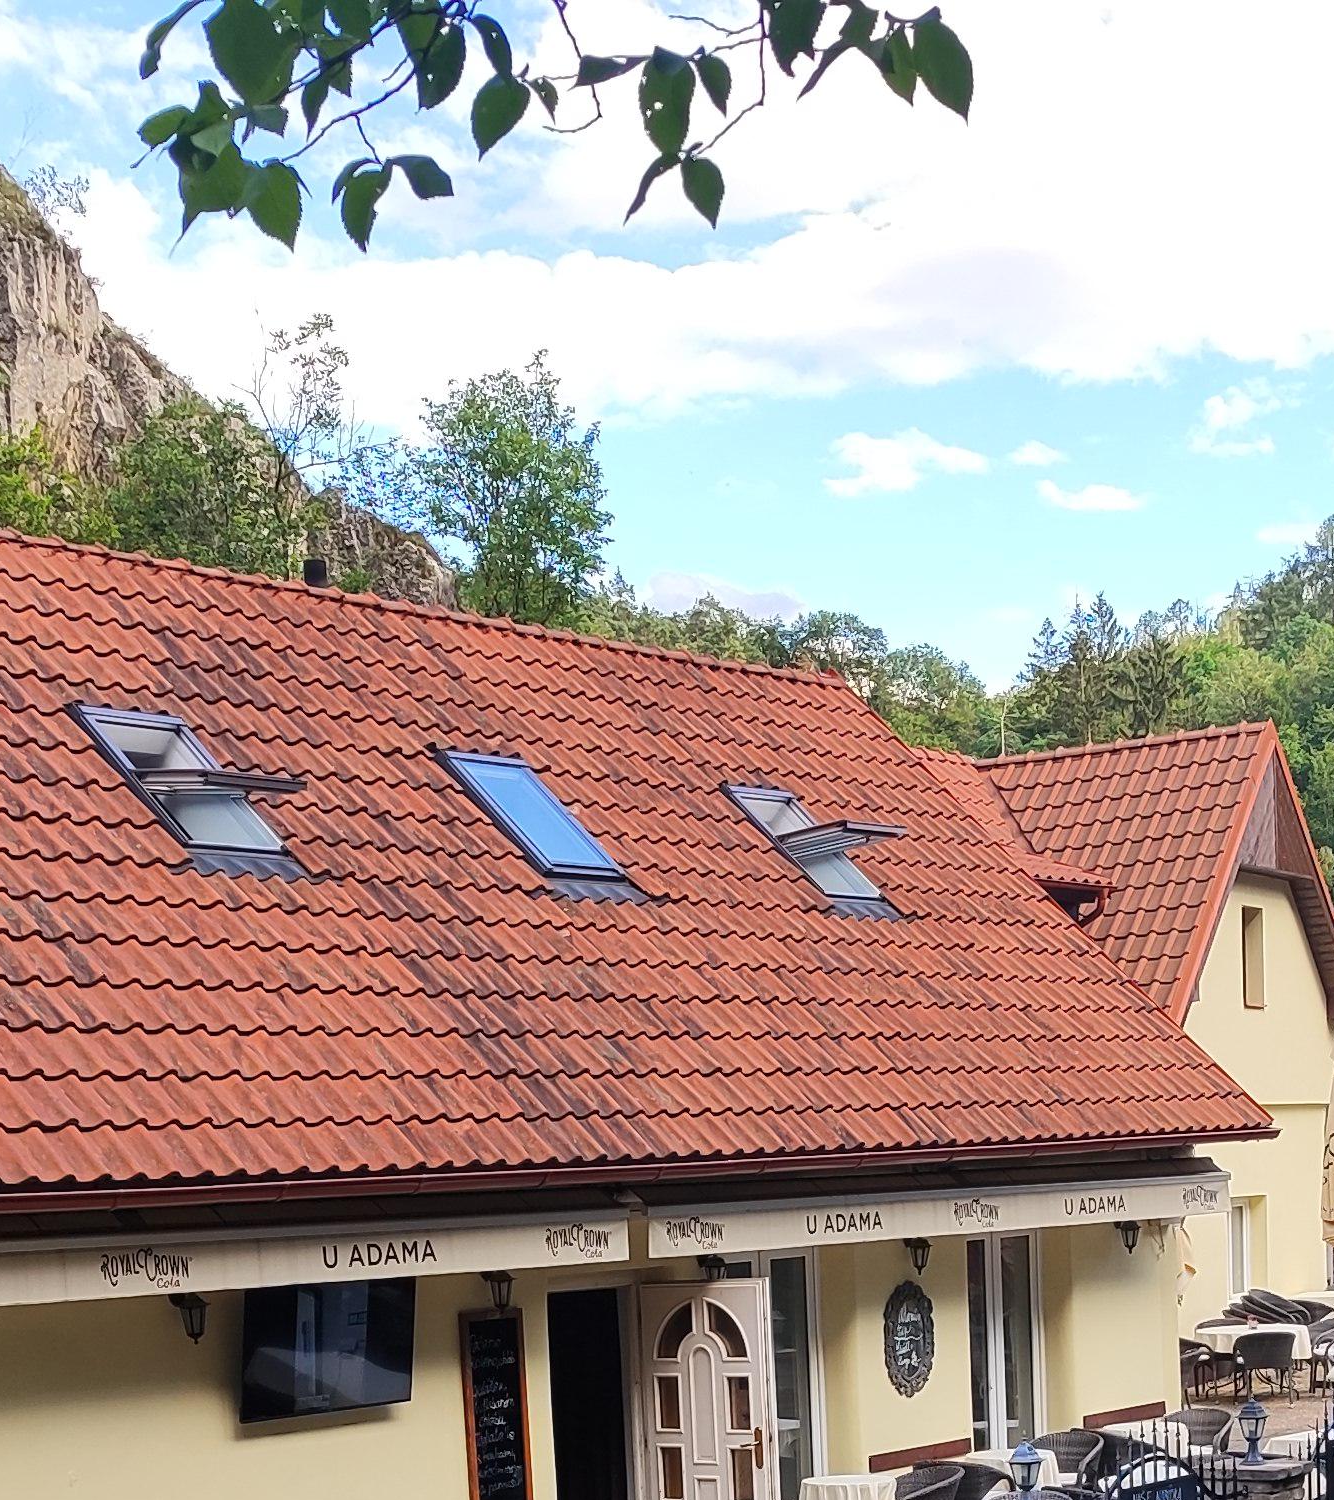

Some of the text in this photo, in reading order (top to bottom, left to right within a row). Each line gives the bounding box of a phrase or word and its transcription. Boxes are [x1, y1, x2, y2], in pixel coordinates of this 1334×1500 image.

[1064, 1195, 1126, 1215] U ADAMA
[666, 1216, 724, 1247] ROYAL CROWN
[806, 1211, 883, 1235] U ADAMA
[322, 1240, 438, 1269] U ADAMA
[545, 1223, 609, 1257] ROYAL CROWN
[100, 1247, 190, 1287] ROYAL CROWN
[156, 1277, 181, 1288] Cola
